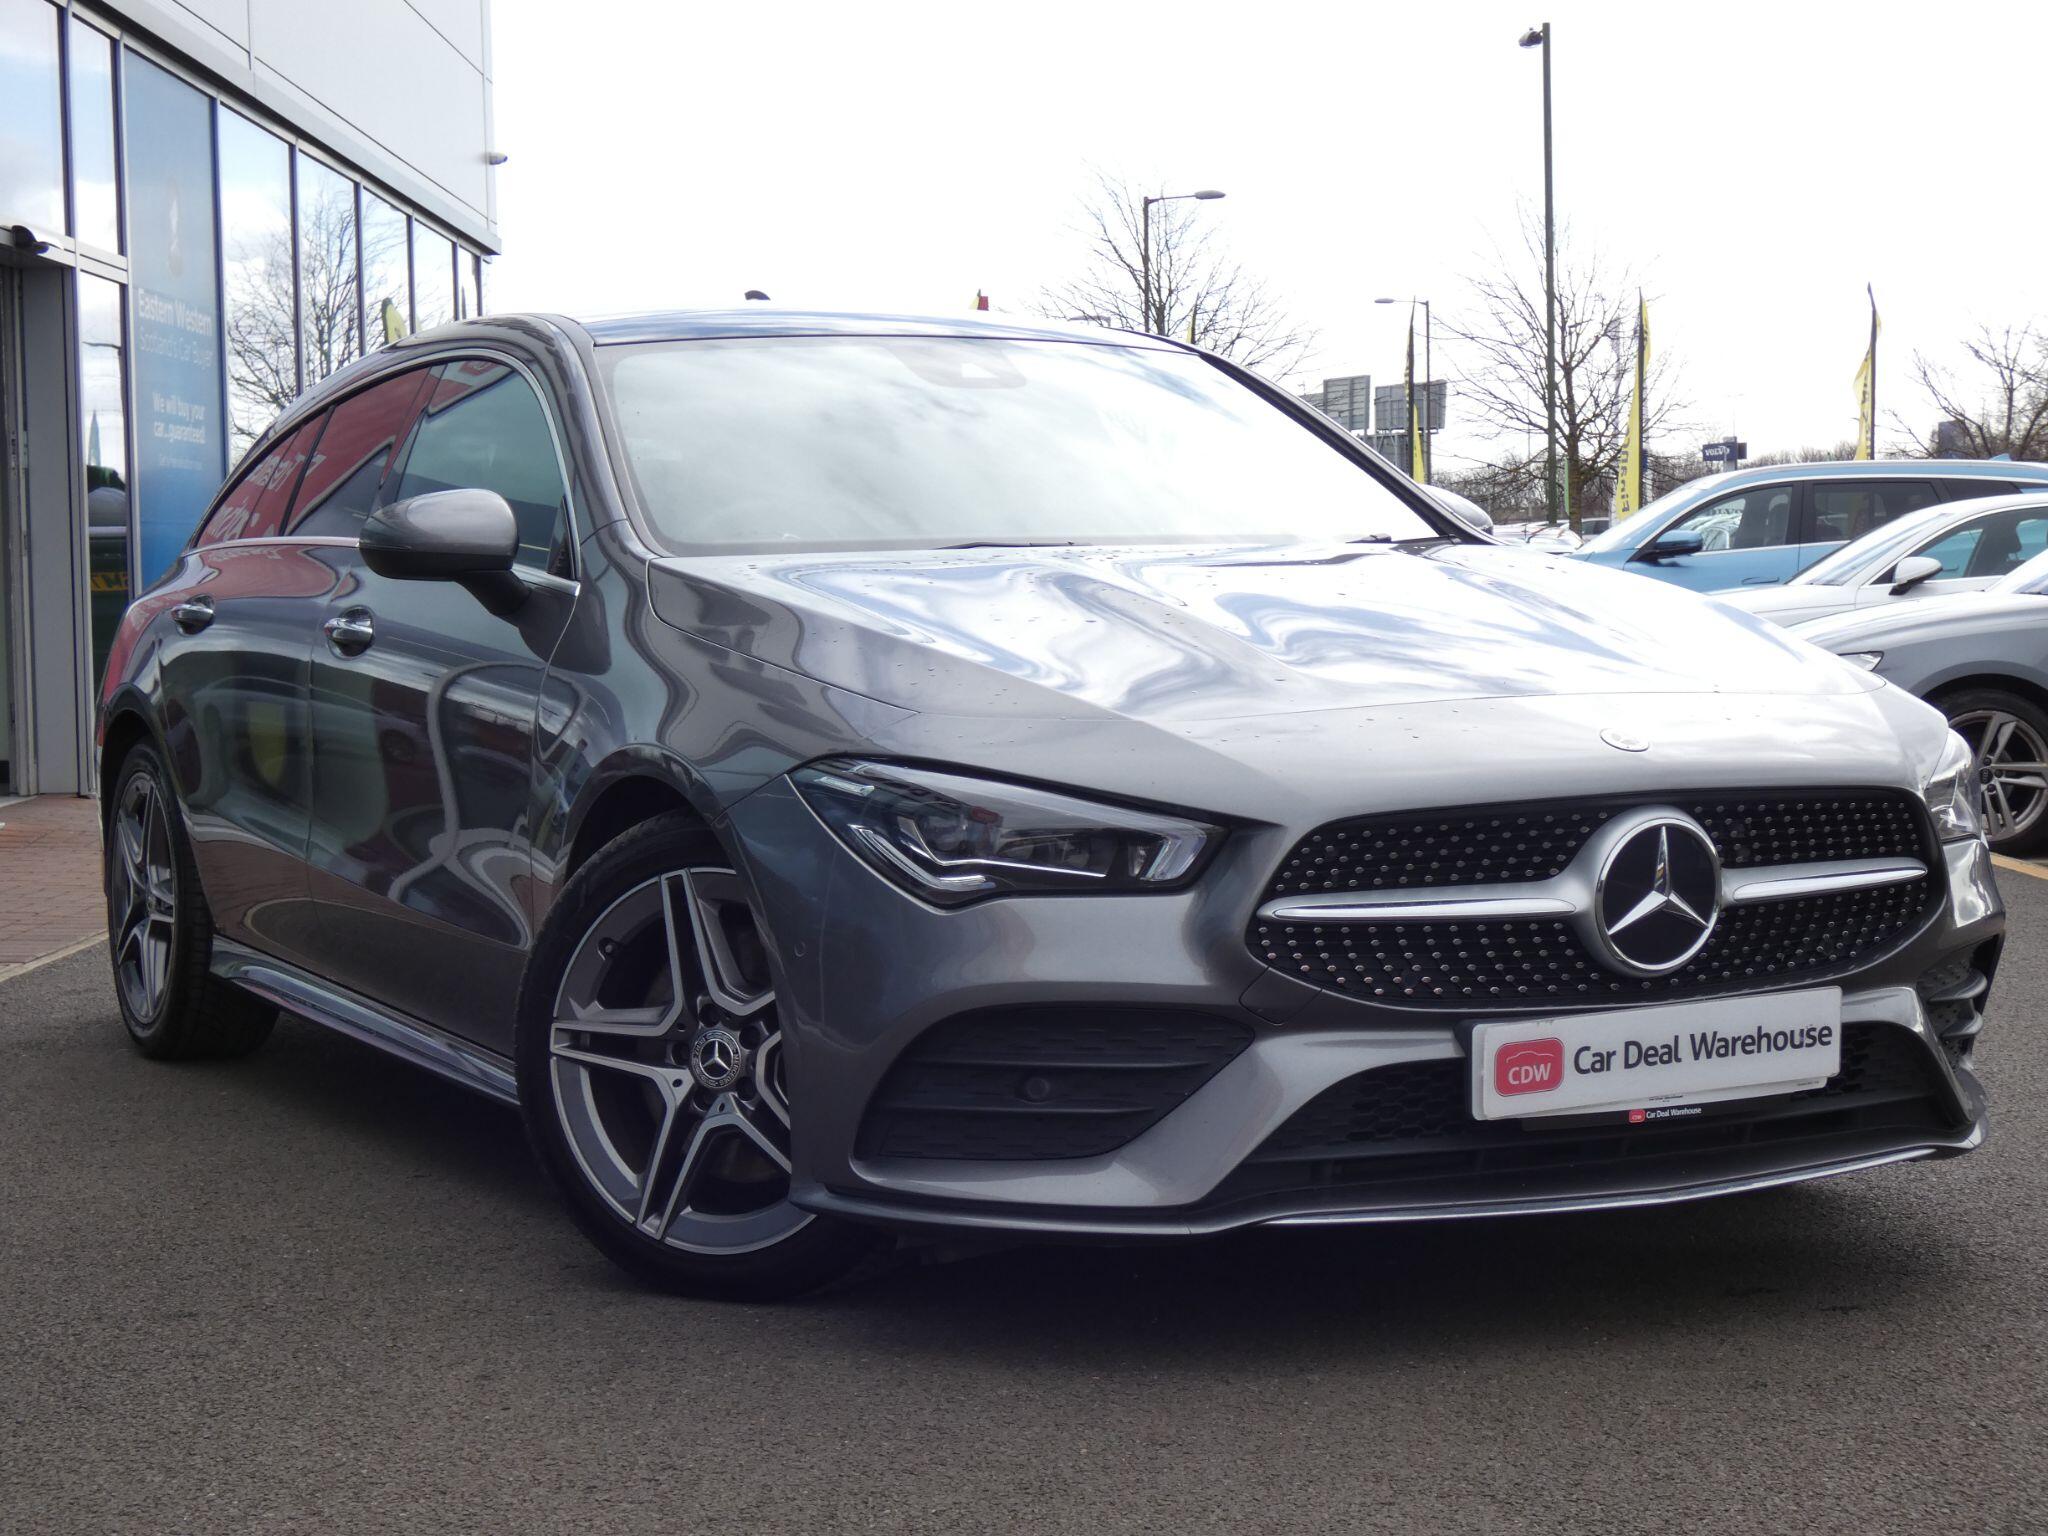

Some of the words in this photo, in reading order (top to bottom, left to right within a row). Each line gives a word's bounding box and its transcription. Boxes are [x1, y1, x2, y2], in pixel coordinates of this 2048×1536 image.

[138, 288, 173, 319] Eastern
[174, 298, 212, 336] Western
[152, 392, 164, 412] We
[176, 396, 187, 421] buy
[188, 403, 204, 421] your
[1704, 447, 1730, 457] VOLVO
[1573, 1045, 1616, 1074] Car
[1624, 1035, 1682, 1069] Deal
[1690, 1025, 1833, 1061] Warehouse
[1508, 1062, 1551, 1085] CDW
[1646, 1111, 1656, 1119] Car
[1656, 1109, 1670, 1118] Deal
[1671, 1107, 1702, 1117] Warehouse
